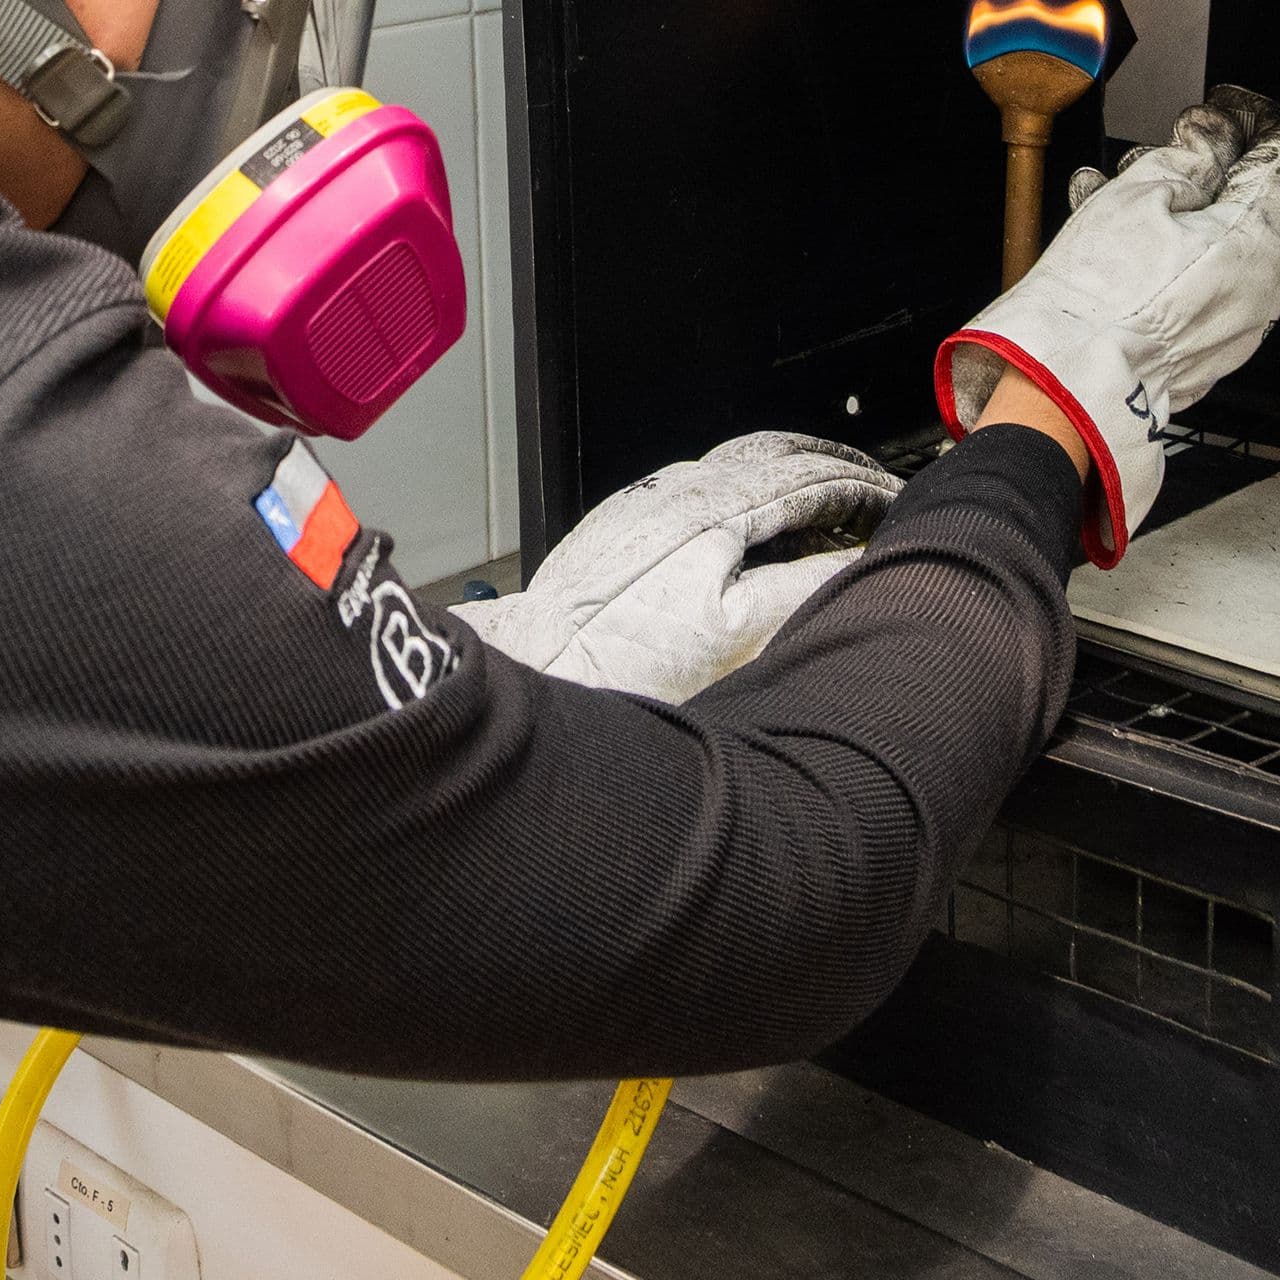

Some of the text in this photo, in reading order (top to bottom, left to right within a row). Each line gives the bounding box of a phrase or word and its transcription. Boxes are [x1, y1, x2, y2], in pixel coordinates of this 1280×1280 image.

[70, 1176, 90, 1198] Cto.
[92, 1189, 100, 1201] F
[106, 1199, 114, 1212] 5
